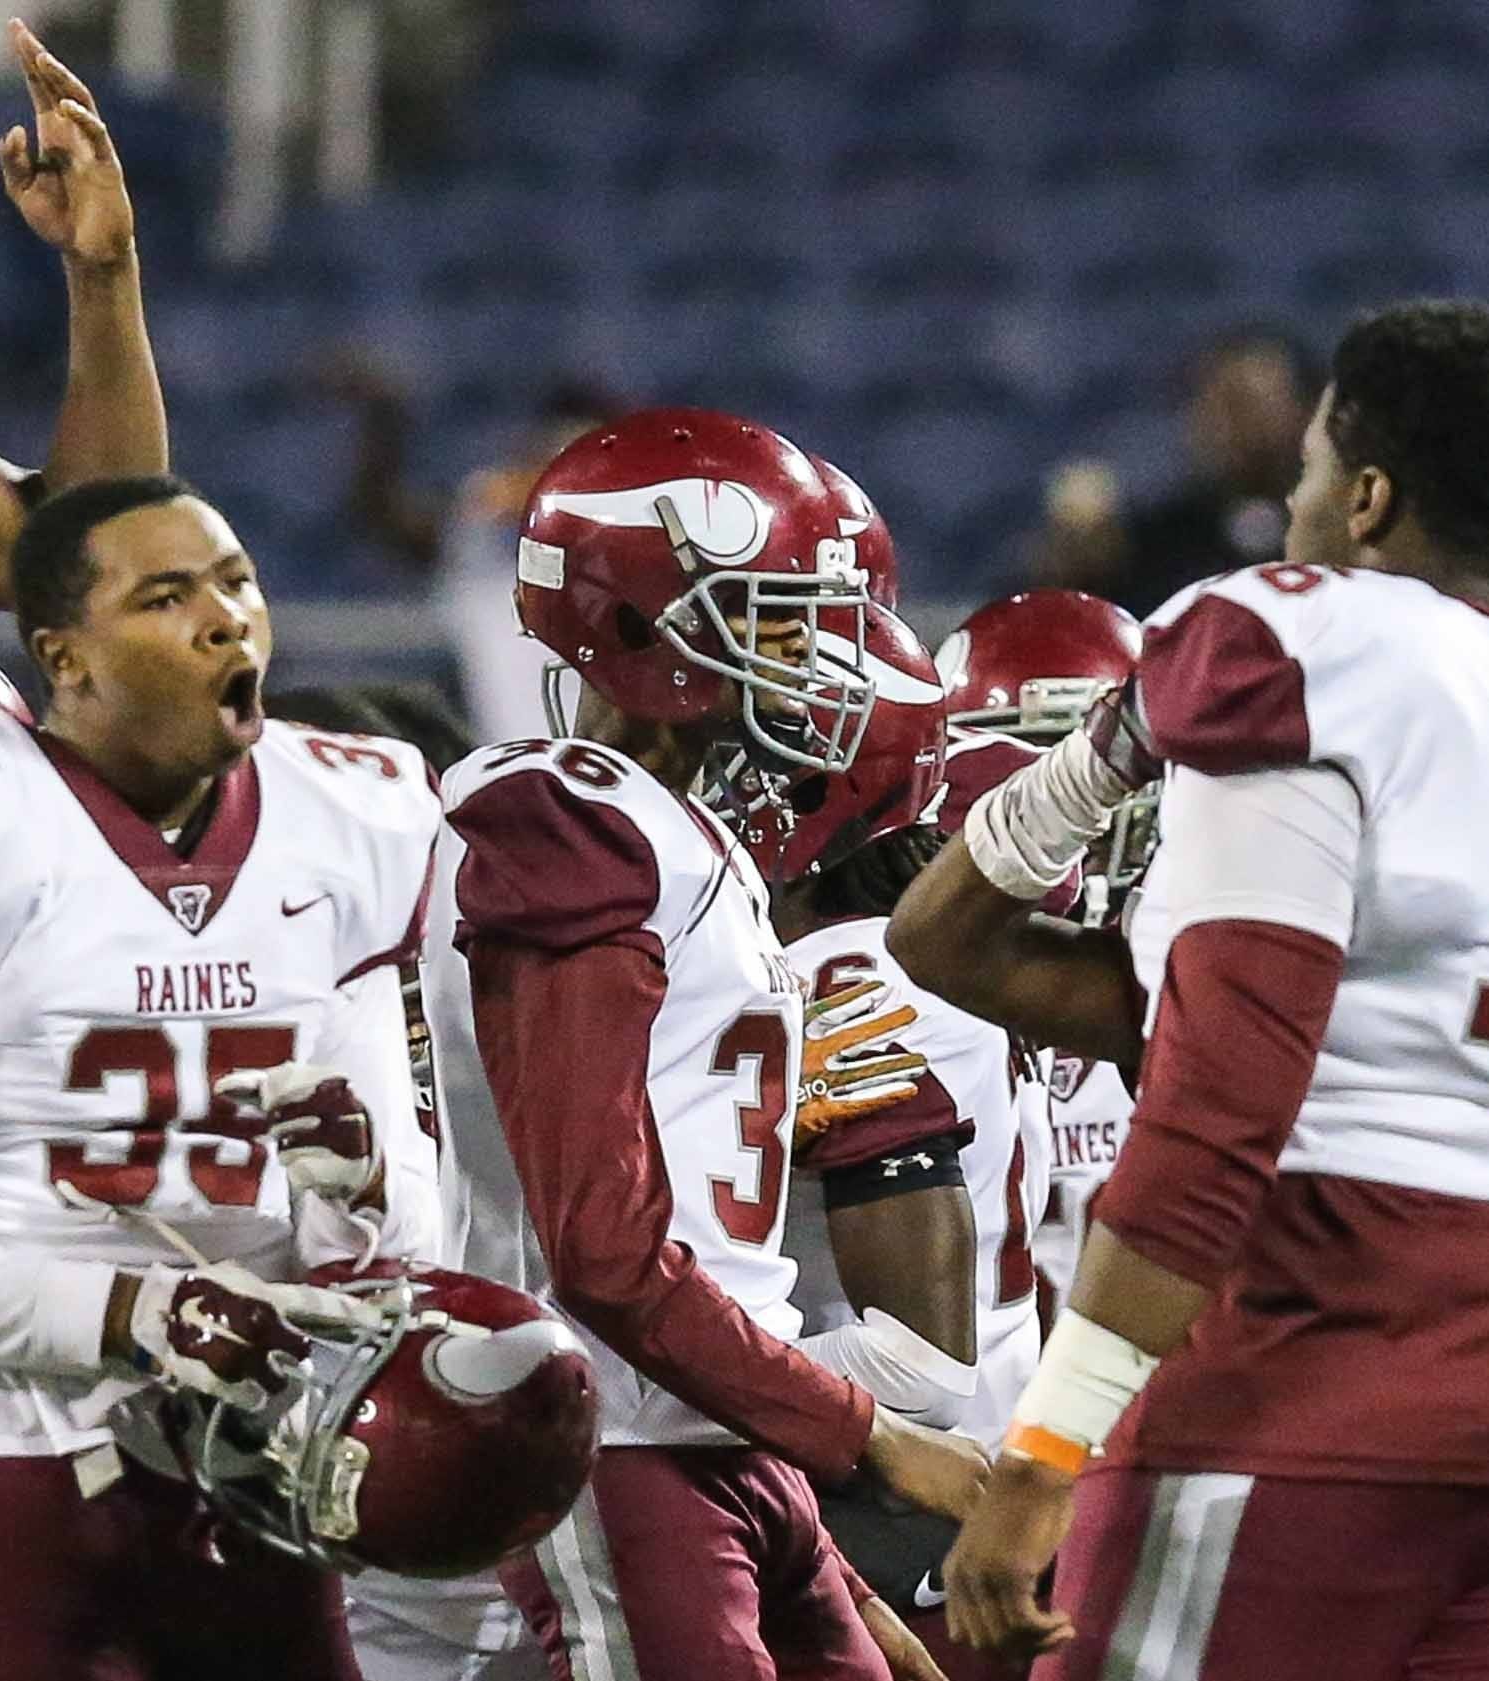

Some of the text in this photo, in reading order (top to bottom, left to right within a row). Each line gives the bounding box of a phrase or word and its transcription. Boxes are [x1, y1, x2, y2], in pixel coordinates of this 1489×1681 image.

[300, 729, 402, 781] 3
[135, 961, 258, 1014] RAINES
[43, 1019, 300, 1209] 35
